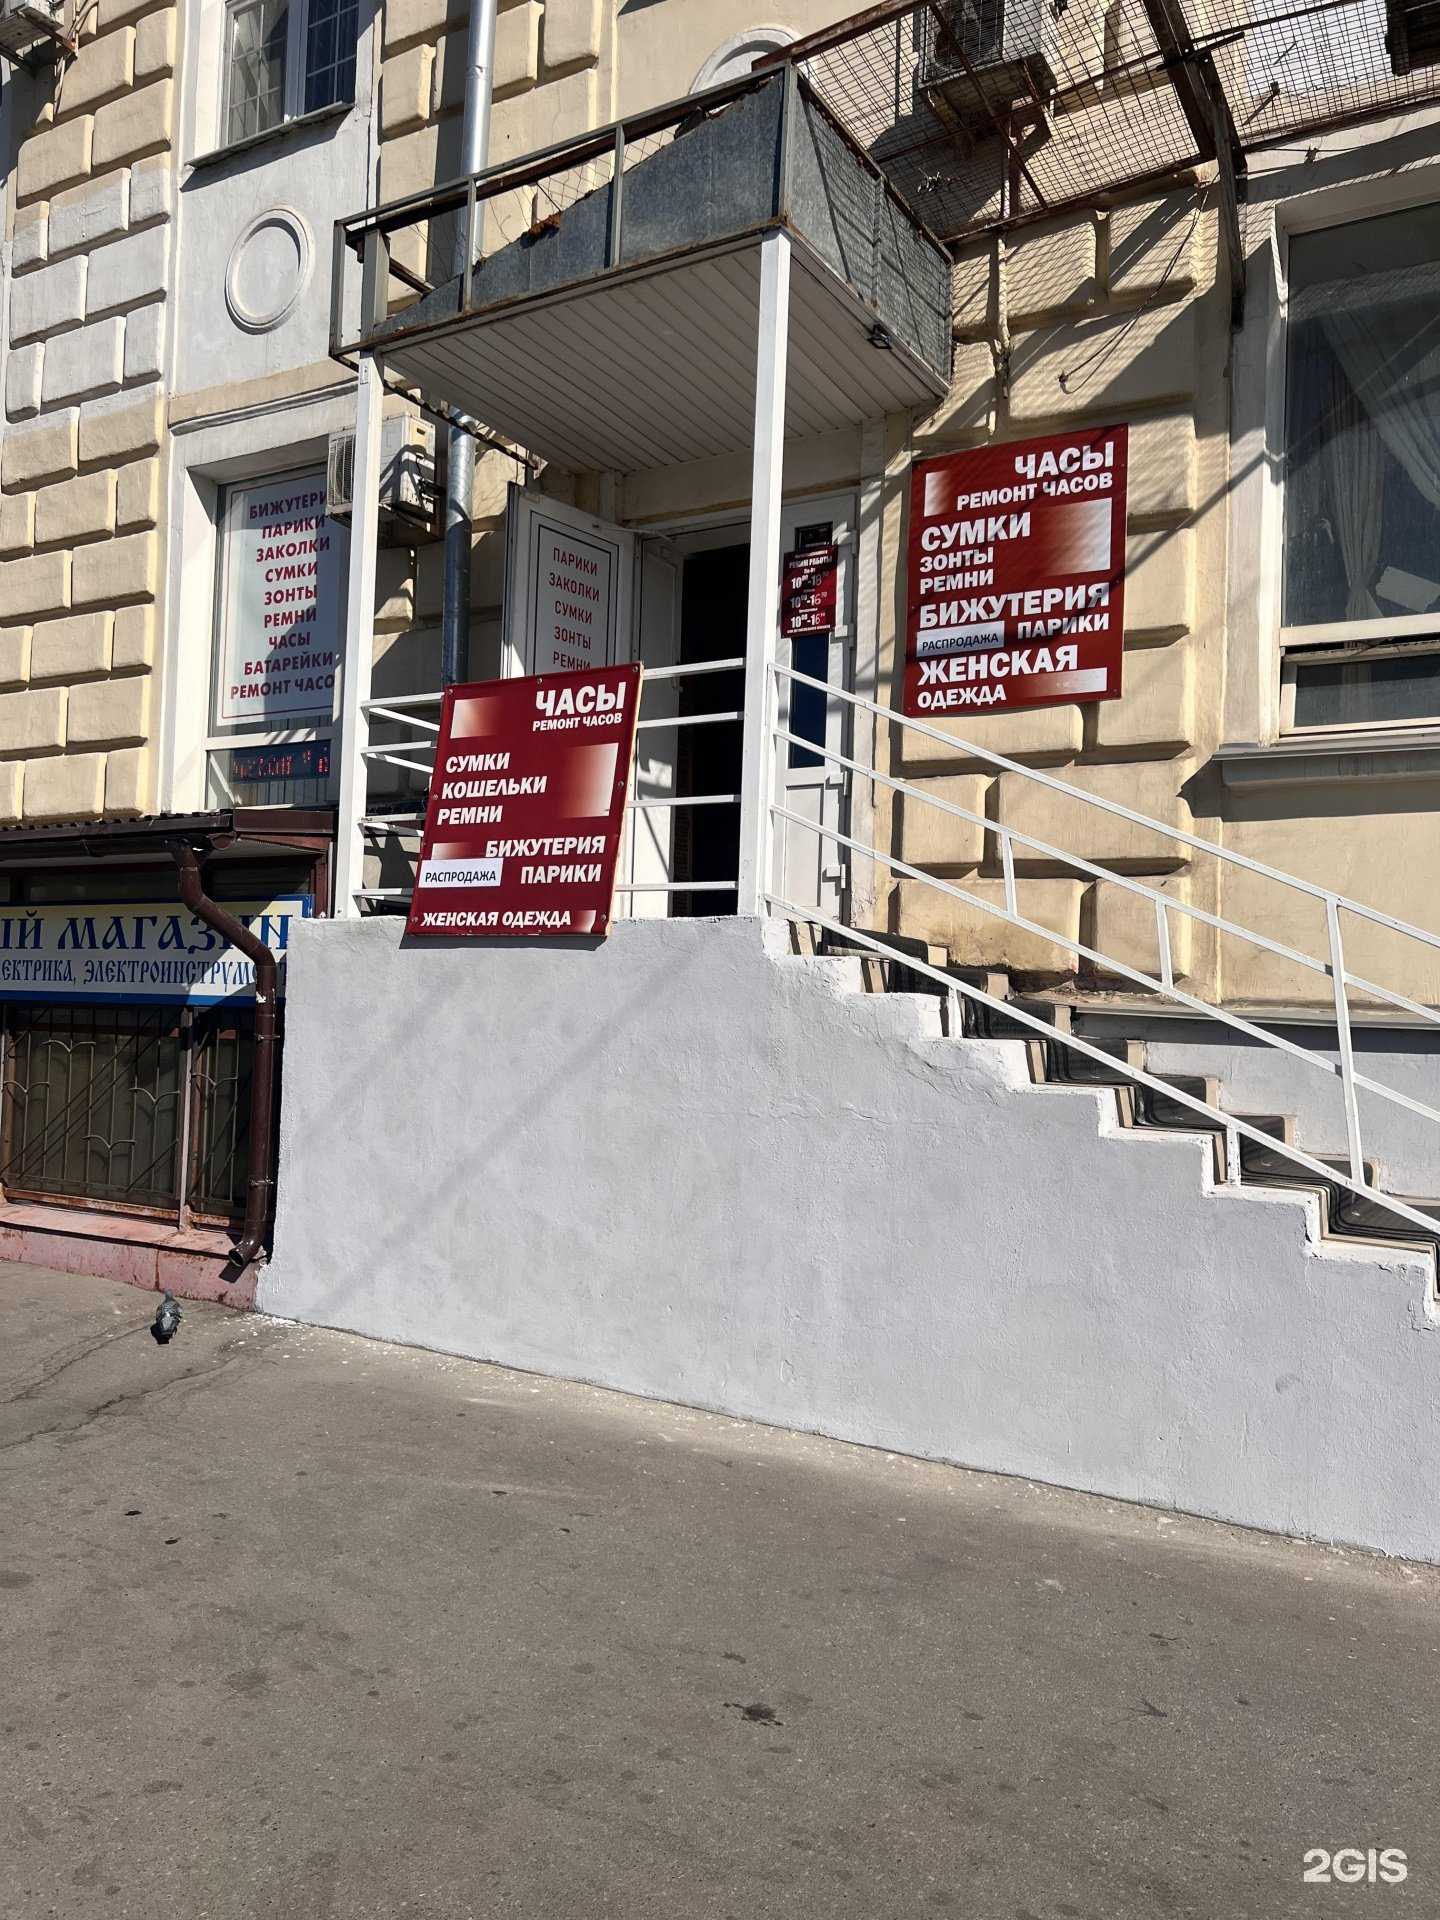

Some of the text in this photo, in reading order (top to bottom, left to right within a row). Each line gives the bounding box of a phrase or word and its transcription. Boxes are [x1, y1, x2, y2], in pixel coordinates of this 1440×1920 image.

[1014, 441, 1114, 479] ЧАСЫ
[957, 472, 1113, 511] РЕМОНТ ЧАСОВ
[250, 490, 328, 520] БИЖУТЕРИ
[262, 513, 325, 539] ПАРИКИ
[921, 511, 1031, 551] СУМКИ
[256, 536, 330, 563] ЗАКОЛКИ
[553, 547, 598, 576] ПАРИКИ
[920, 547, 994, 573] ЗОНТЫ
[265, 561, 318, 583] СУМКИ
[920, 569, 994, 594] РЕМНИ
[264, 584, 318, 606] ЗОНТЫ
[549, 572, 600, 601] ЗАКОЛКИ
[554, 600, 593, 625] СУМКИ
[919, 582, 1109, 628] БИЖУТЕРИЯ
[264, 607, 317, 629] РЕМНИ
[1018, 613, 1109, 640] ПАРИКИ
[269, 632, 311, 650] ЧАСЫ
[554, 626, 591, 650] ЗОНТЫ
[922, 632, 999, 651] РАСПРОДАЖА
[244, 650, 333, 676] БАТАРЕЙКИ
[553, 651, 591, 672] РЕМНИ
[918, 644, 1078, 686] ЖЕНСКАЯ
[230, 674, 335, 700] РЕМОНТ ЧАСО
[535, 682, 627, 717] ЧАСЫ
[917, 684, 1007, 710] ОДЕЖДА
[532, 713, 622, 732] РЕМОНТ ЧАСОВ
[445, 752, 510, 774] СУМКИ
[442, 776, 547, 800] КОШЕЛЬКИ
[437, 805, 503, 825] РЕМНИ
[485, 836, 606, 858] БИЖУТЕРИЯ
[425, 870, 496, 883] РАСПРОДАЖА
[520, 864, 602, 885] ПАРИКИ
[420, 910, 571, 928] ЖЕНСКАЯ ОДЕЖДА
[0, 959, 76, 984] ЕКТРИКА,
